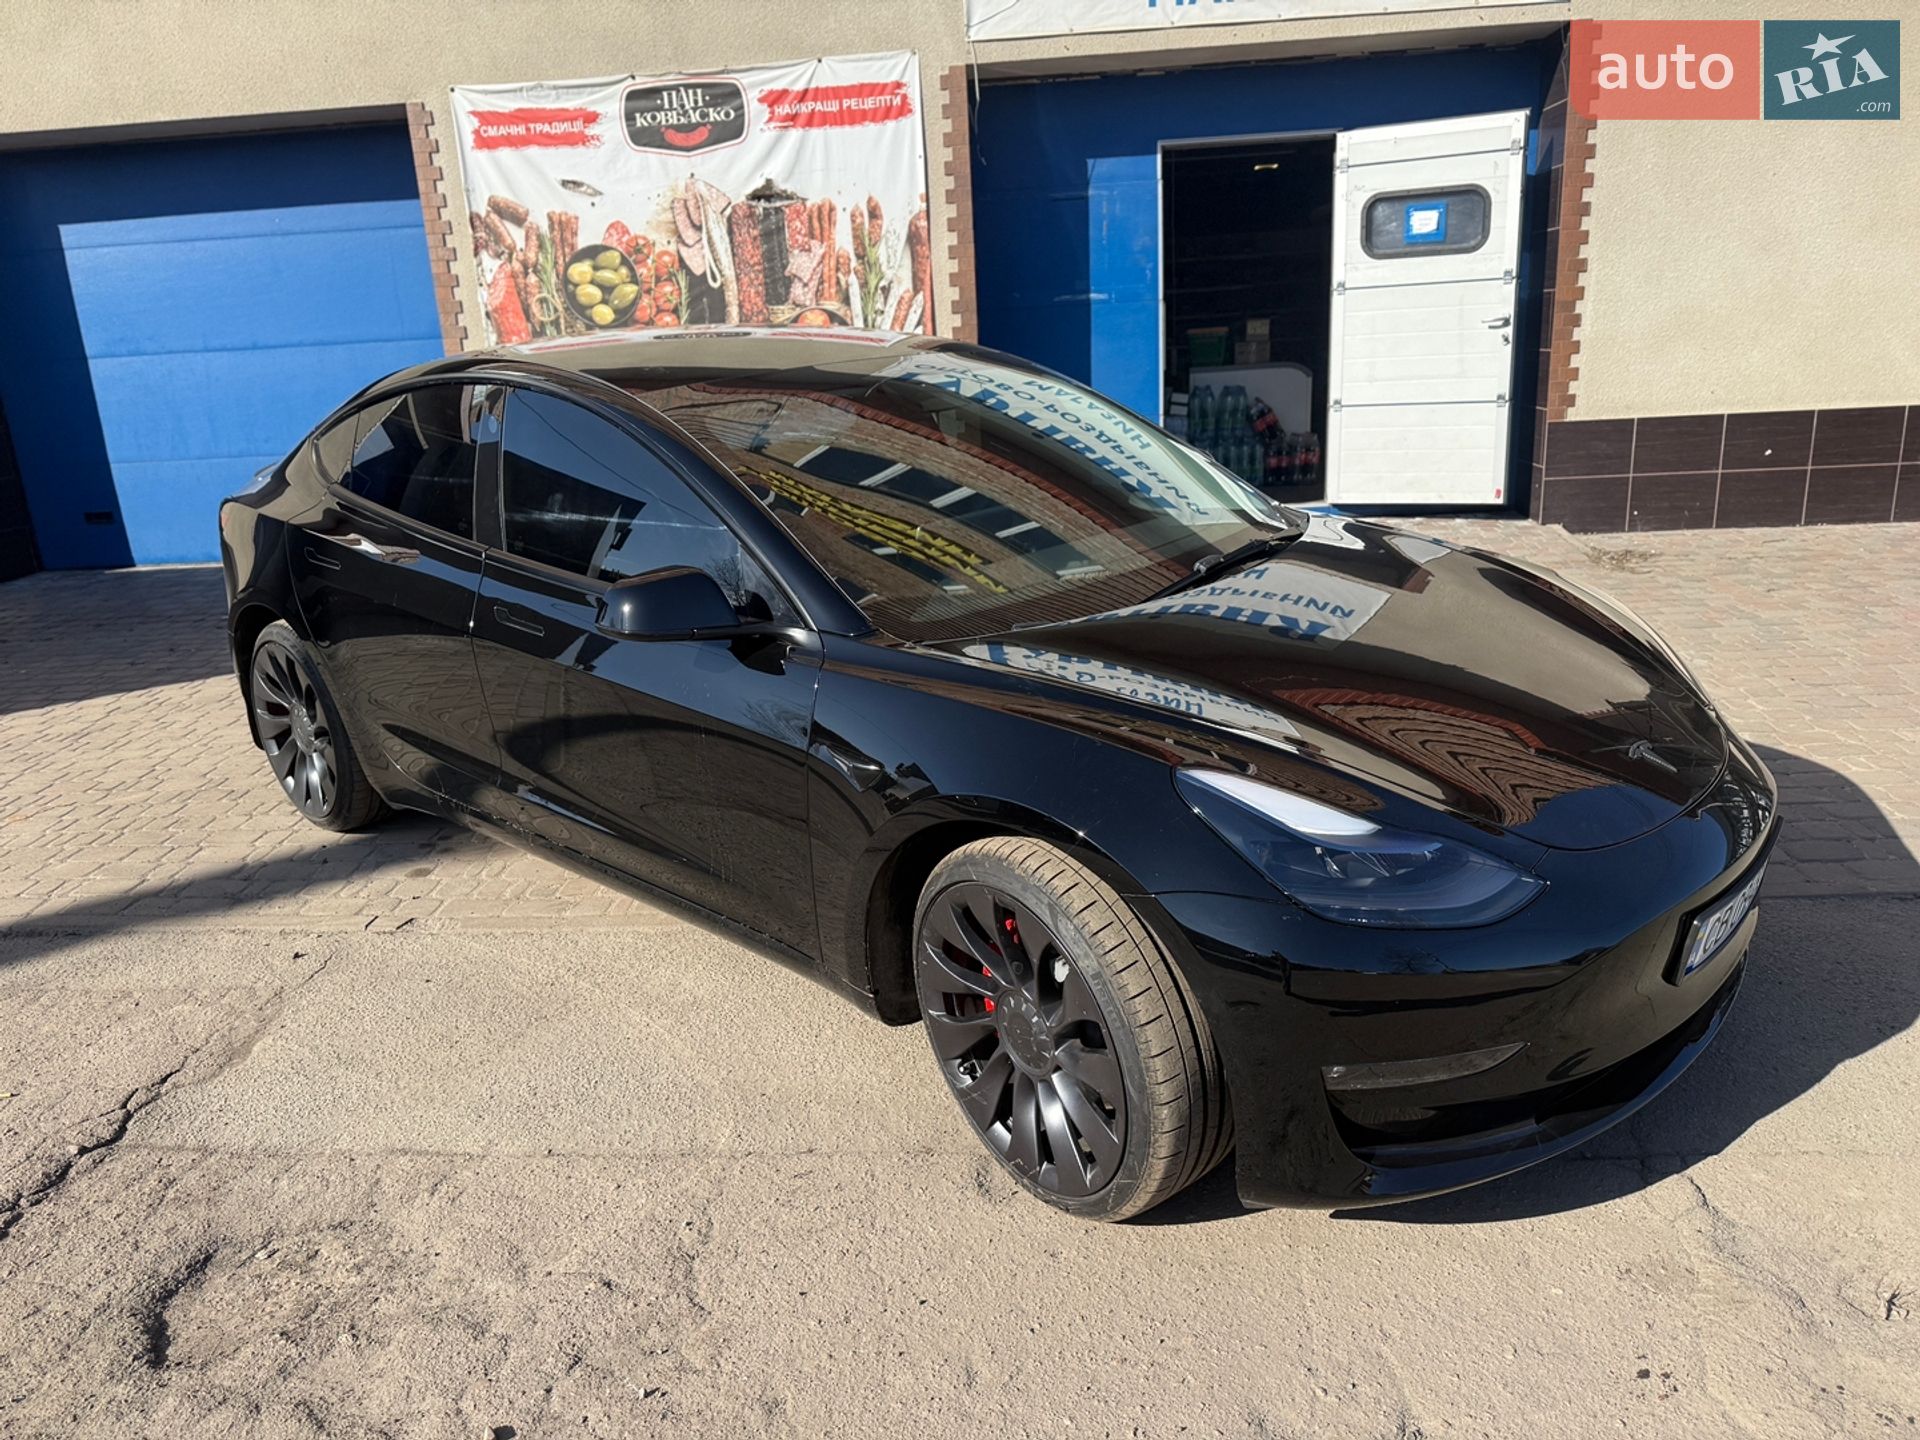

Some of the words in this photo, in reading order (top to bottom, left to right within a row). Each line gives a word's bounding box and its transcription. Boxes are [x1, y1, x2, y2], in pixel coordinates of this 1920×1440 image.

[662, 87, 704, 111] ПАН
[774, 98, 840, 116] НАЙКРАЩІ
[842, 94, 902, 110] РЕЦЕПТИ
[480, 122, 526, 137] СМАЧНІ
[528, 118, 584, 134] ТРАДИЦІЇ
[634, 105, 736, 128] КОВБАСКО
